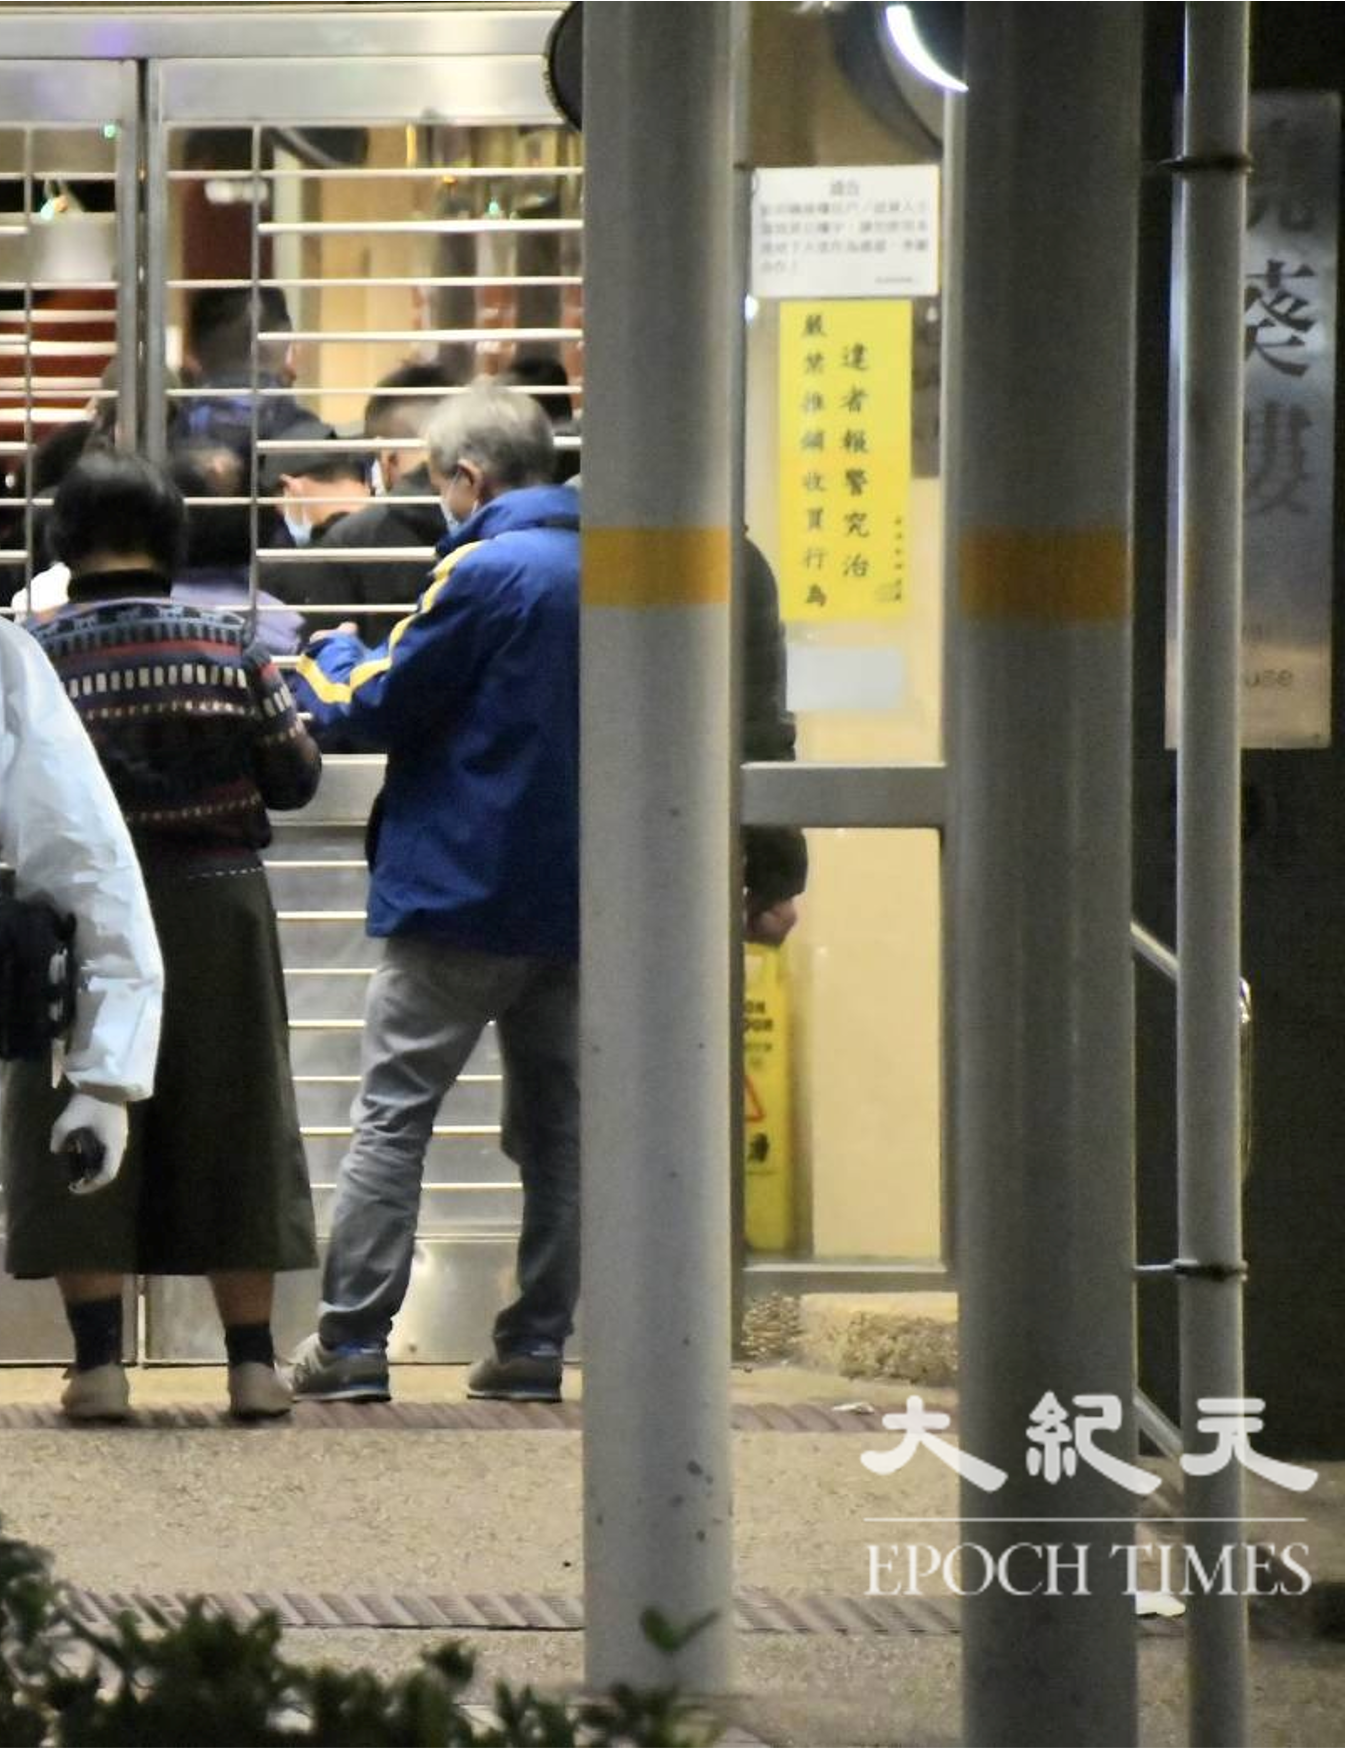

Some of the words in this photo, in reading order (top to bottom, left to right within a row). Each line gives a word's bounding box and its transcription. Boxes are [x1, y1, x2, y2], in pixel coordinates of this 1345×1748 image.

[840, 342, 870, 578] 違者報警究治
